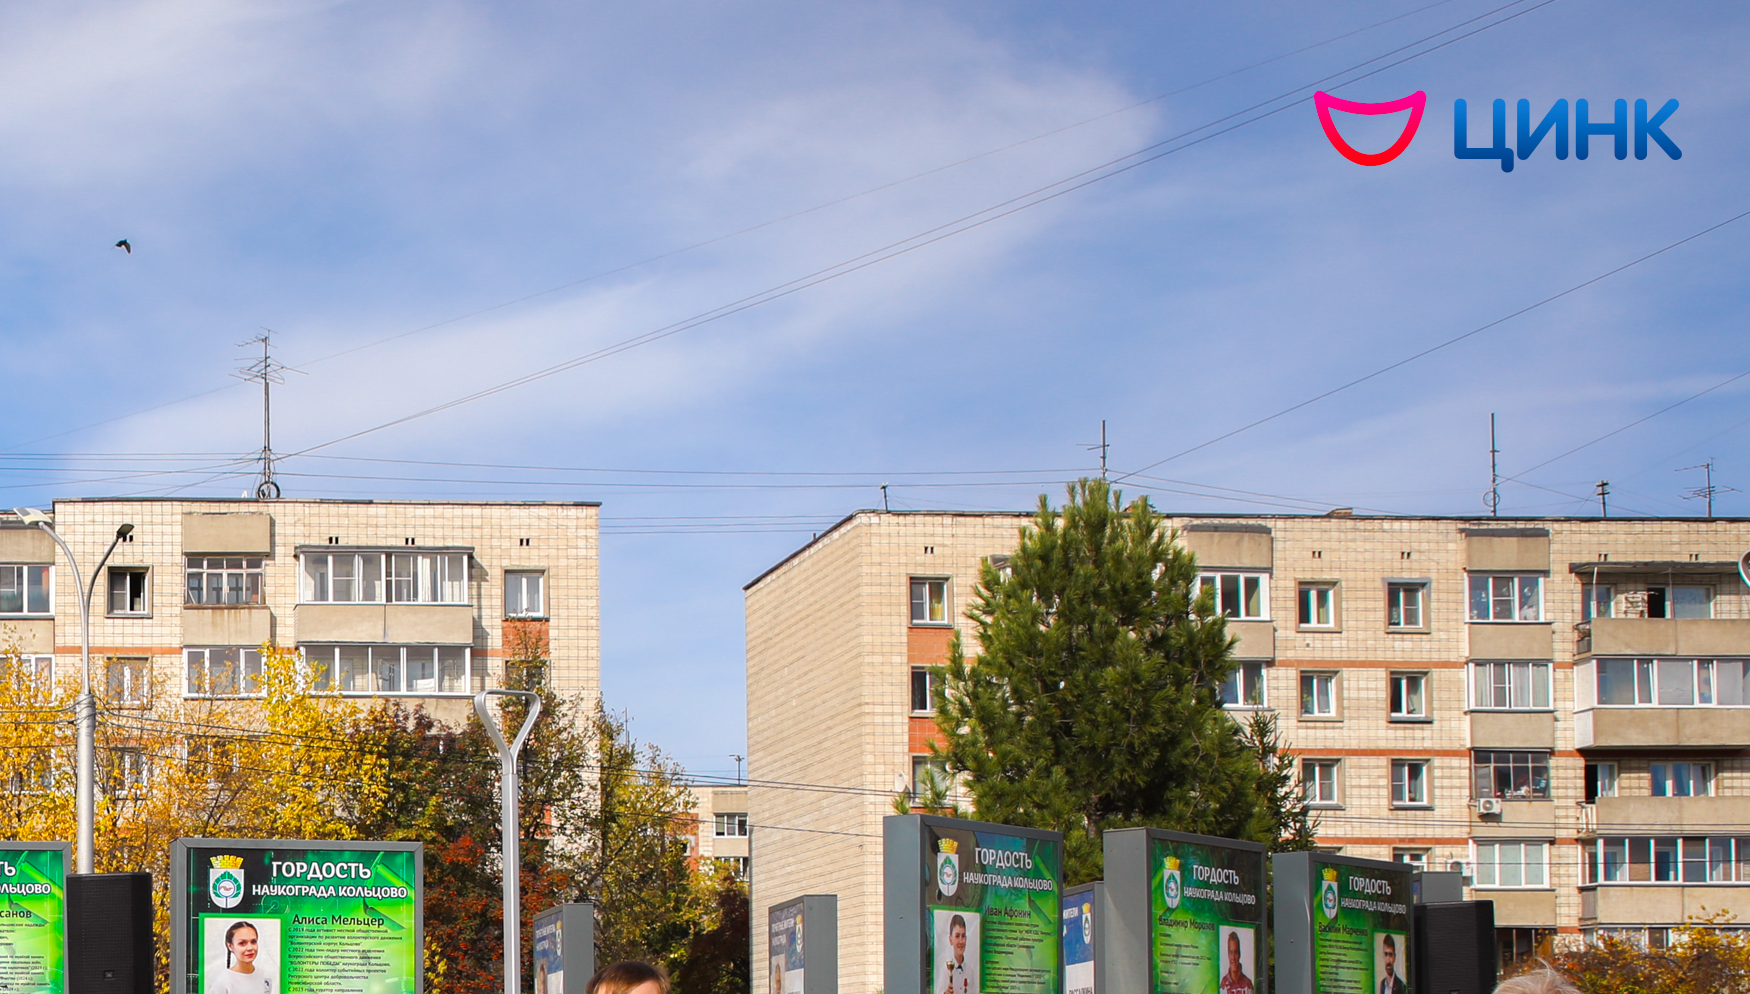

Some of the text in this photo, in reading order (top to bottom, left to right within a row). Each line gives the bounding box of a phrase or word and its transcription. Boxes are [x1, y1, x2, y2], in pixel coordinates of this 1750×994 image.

[974, 847, 1032, 870] ГОРДОСТЬ
[272, 861, 372, 880] ГОРДОСТЬ
[1193, 865, 1240, 885] ГОРДОСТЬ
[963, 871, 1053, 891] НАУКОГРАДА КОЛЬЦОВО
[1349, 876, 1391, 895] ГОРДОСТЬ
[252, 885, 408, 900] НАУКОГРАДА КОЛЬЦОВО
[1183, 886, 1256, 906] НАУКОГРАДА КОЛЬЦОВО
[985, 906, 1031, 919] Иван Афонин
[1341, 897, 1406, 915] НАУКОГРАДА КОЛЬЦОВО
[292, 915, 384, 928] Алиса Мельцер
